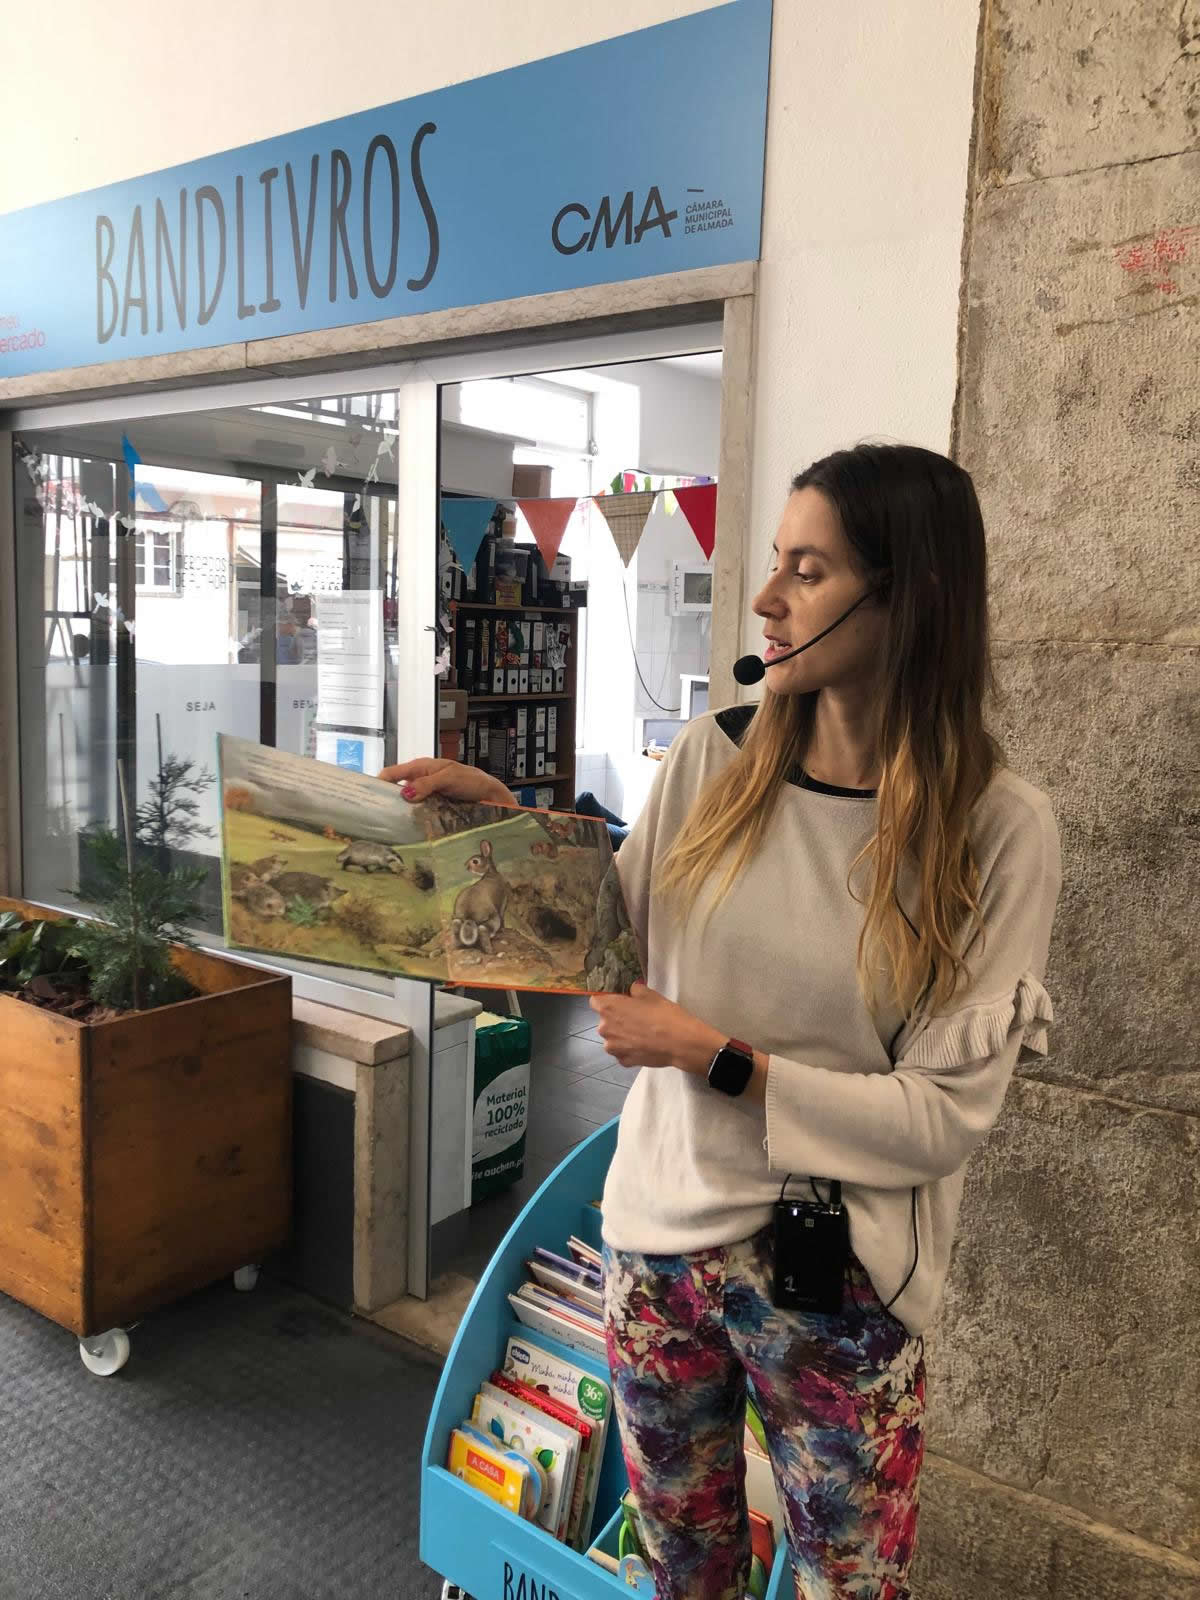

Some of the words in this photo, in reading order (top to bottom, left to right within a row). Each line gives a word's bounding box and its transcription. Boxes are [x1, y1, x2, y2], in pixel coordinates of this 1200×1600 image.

[685, 200, 724, 214] CÂMARA
[685, 208, 733, 224] MUNICIPAL
[551, 186, 679, 256] CMA
[684, 225, 696, 235] DE
[697, 218, 734, 232] ALMADA
[95, 121, 440, 344] BANDLIVROS
[186, 701, 217, 712] SEJA
[486, 1086, 527, 1107] Material
[486, 1101, 525, 1127] 100%
[484, 1117, 524, 1140] reciclado
[479, 1460, 499, 1481] CASA
[503, 1561, 560, 1600] BA
